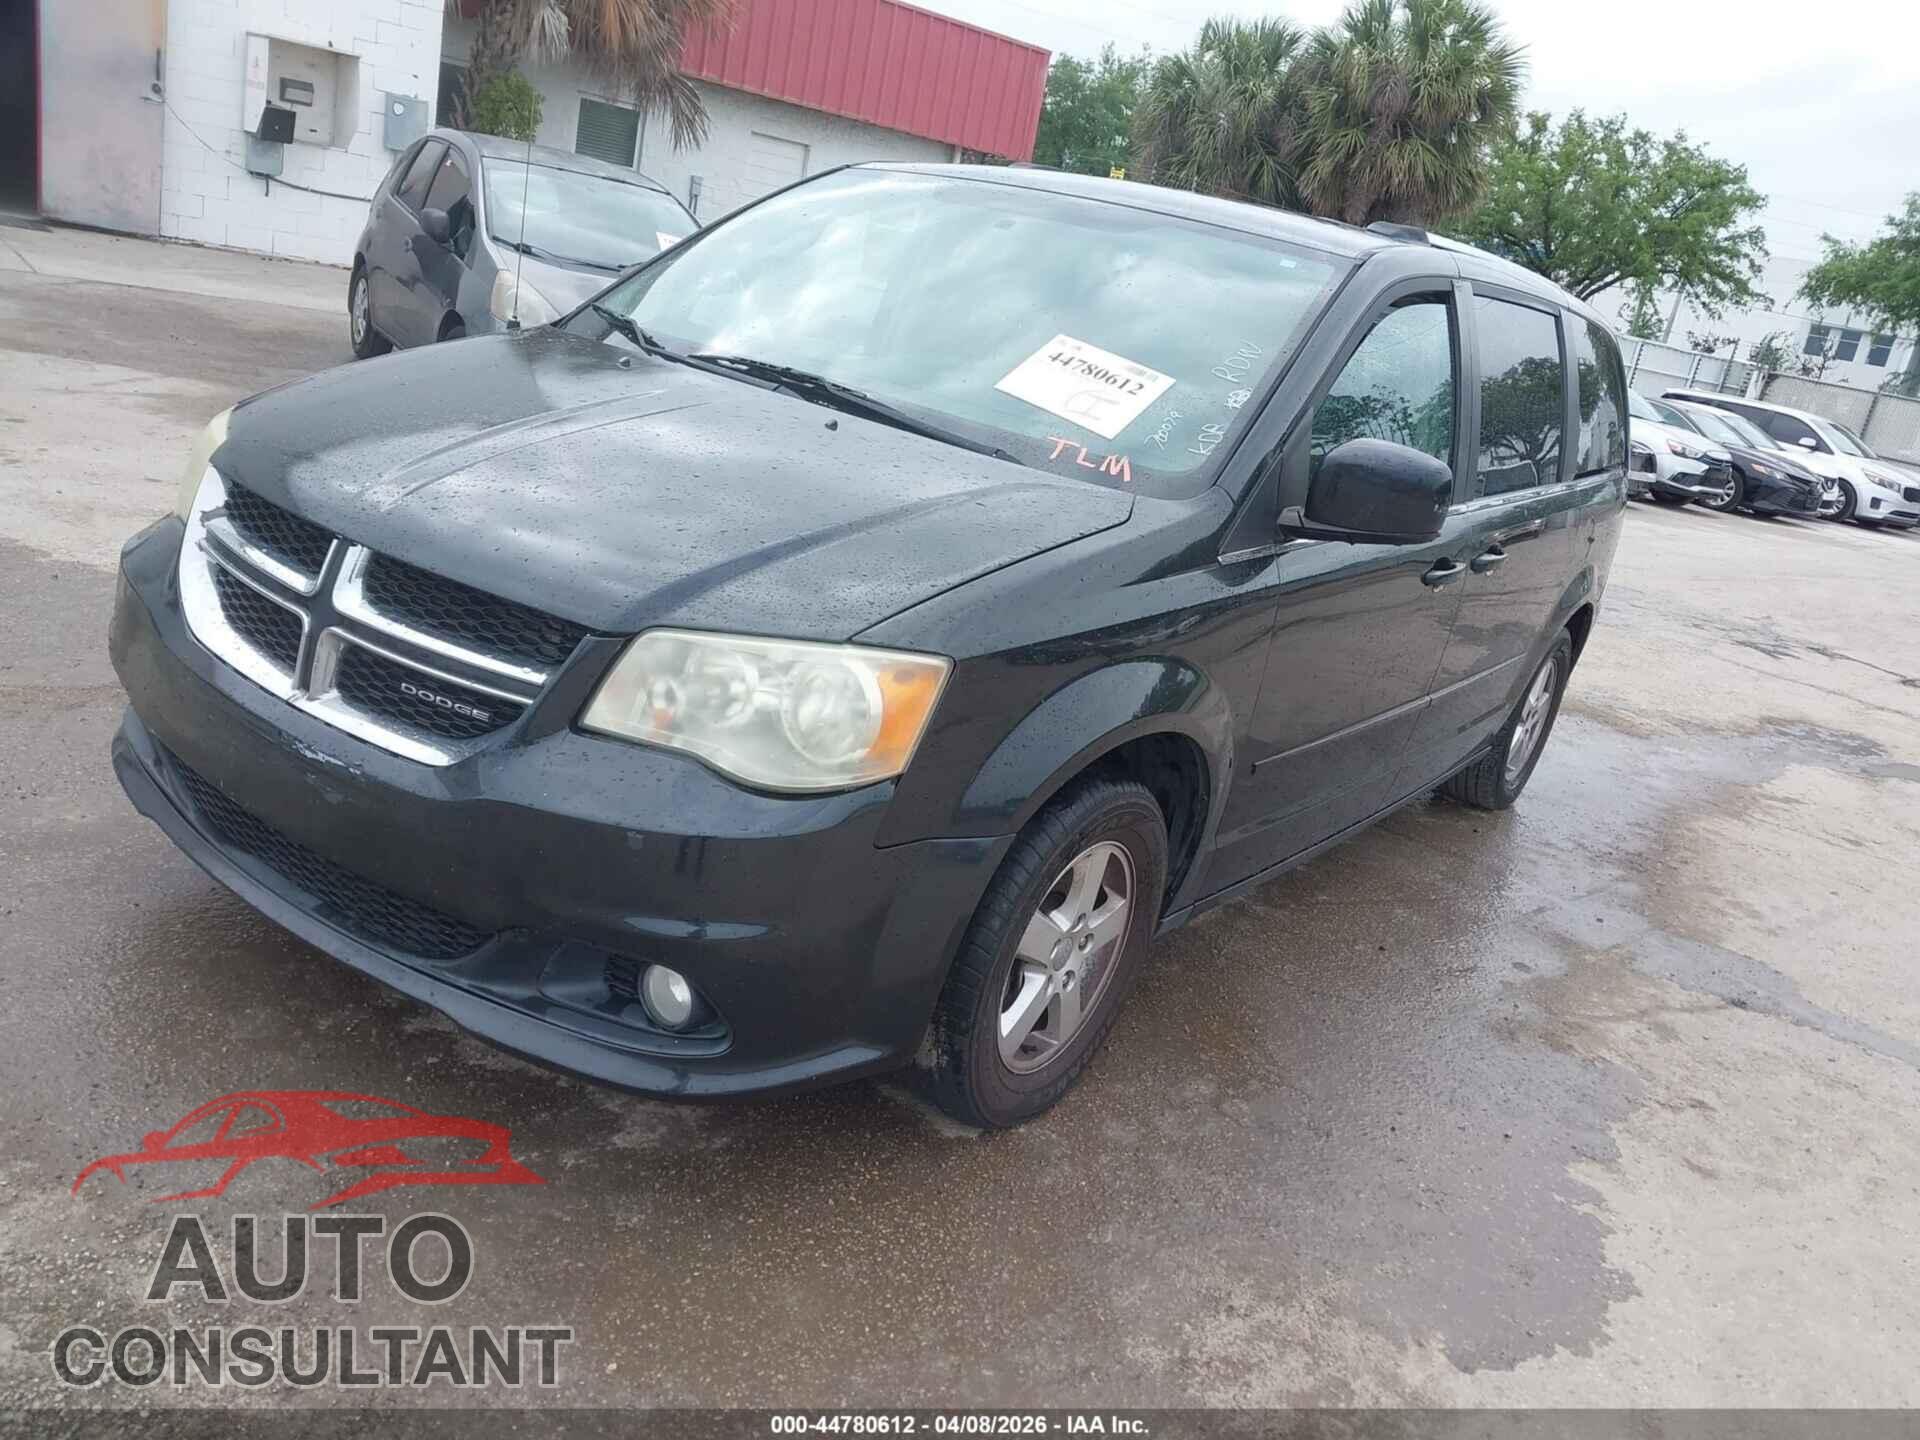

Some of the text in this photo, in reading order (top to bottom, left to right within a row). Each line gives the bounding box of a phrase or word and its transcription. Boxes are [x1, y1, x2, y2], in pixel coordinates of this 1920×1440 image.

[1048, 351, 1145, 396] 44780612
[1047, 436, 1132, 482] TLM
[400, 682, 490, 722] DODGE
